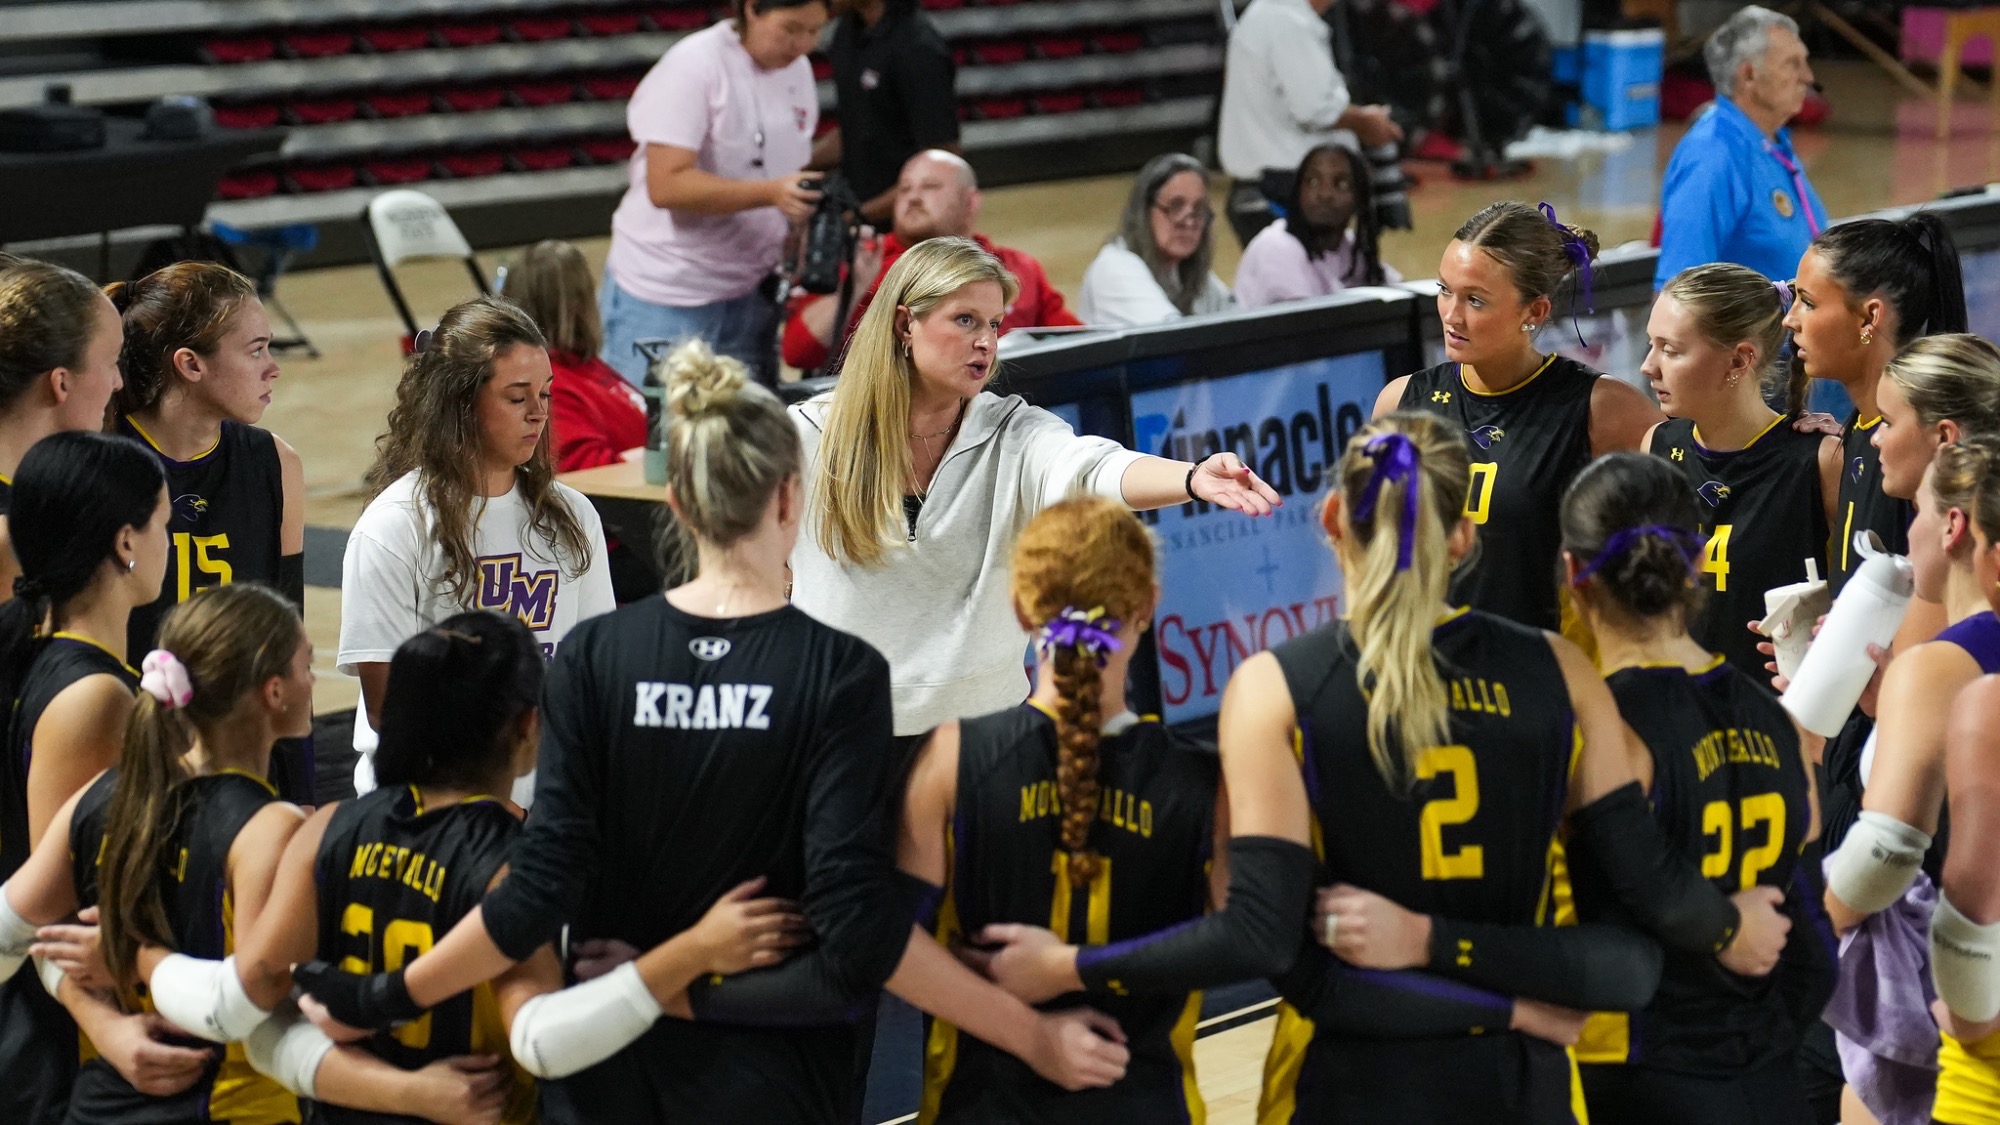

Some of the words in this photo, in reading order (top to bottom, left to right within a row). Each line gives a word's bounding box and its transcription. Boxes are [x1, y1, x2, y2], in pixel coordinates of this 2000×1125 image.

[172, 532, 233, 604] 15
[473, 552, 559, 632] UM
[1699, 523, 1733, 592] 4
[633, 681, 774, 730] KRANZ
[1416, 745, 1483, 880] 2
[1051, 849, 1112, 946] 11
